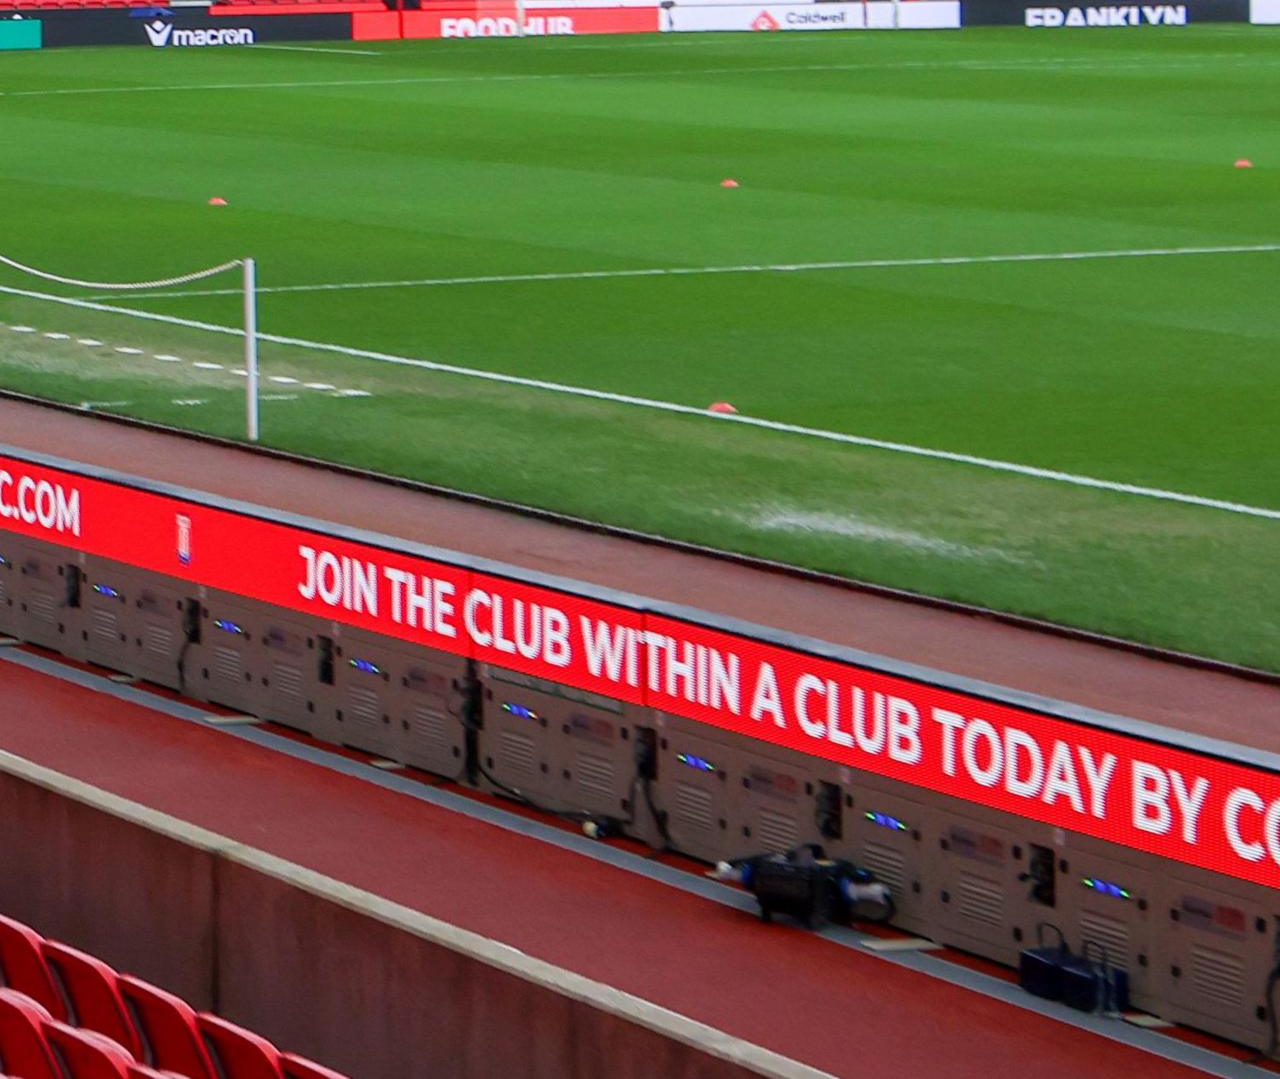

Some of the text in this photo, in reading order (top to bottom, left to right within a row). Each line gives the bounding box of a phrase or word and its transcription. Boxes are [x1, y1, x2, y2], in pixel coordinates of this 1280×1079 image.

[786, 11, 847, 24] Caldwell
[172, 27, 254, 46] macron
[296, 545, 378, 617] JOIN
[384, 565, 457, 638] THE
[463, 587, 572, 667] CLUB
[578, 614, 741, 715] WITHIN
[750, 662, 786, 728] A
[794, 673, 923, 766] CLUB
[931, 706, 1118, 820] TODAY
[1131, 759, 1212, 845] BY
